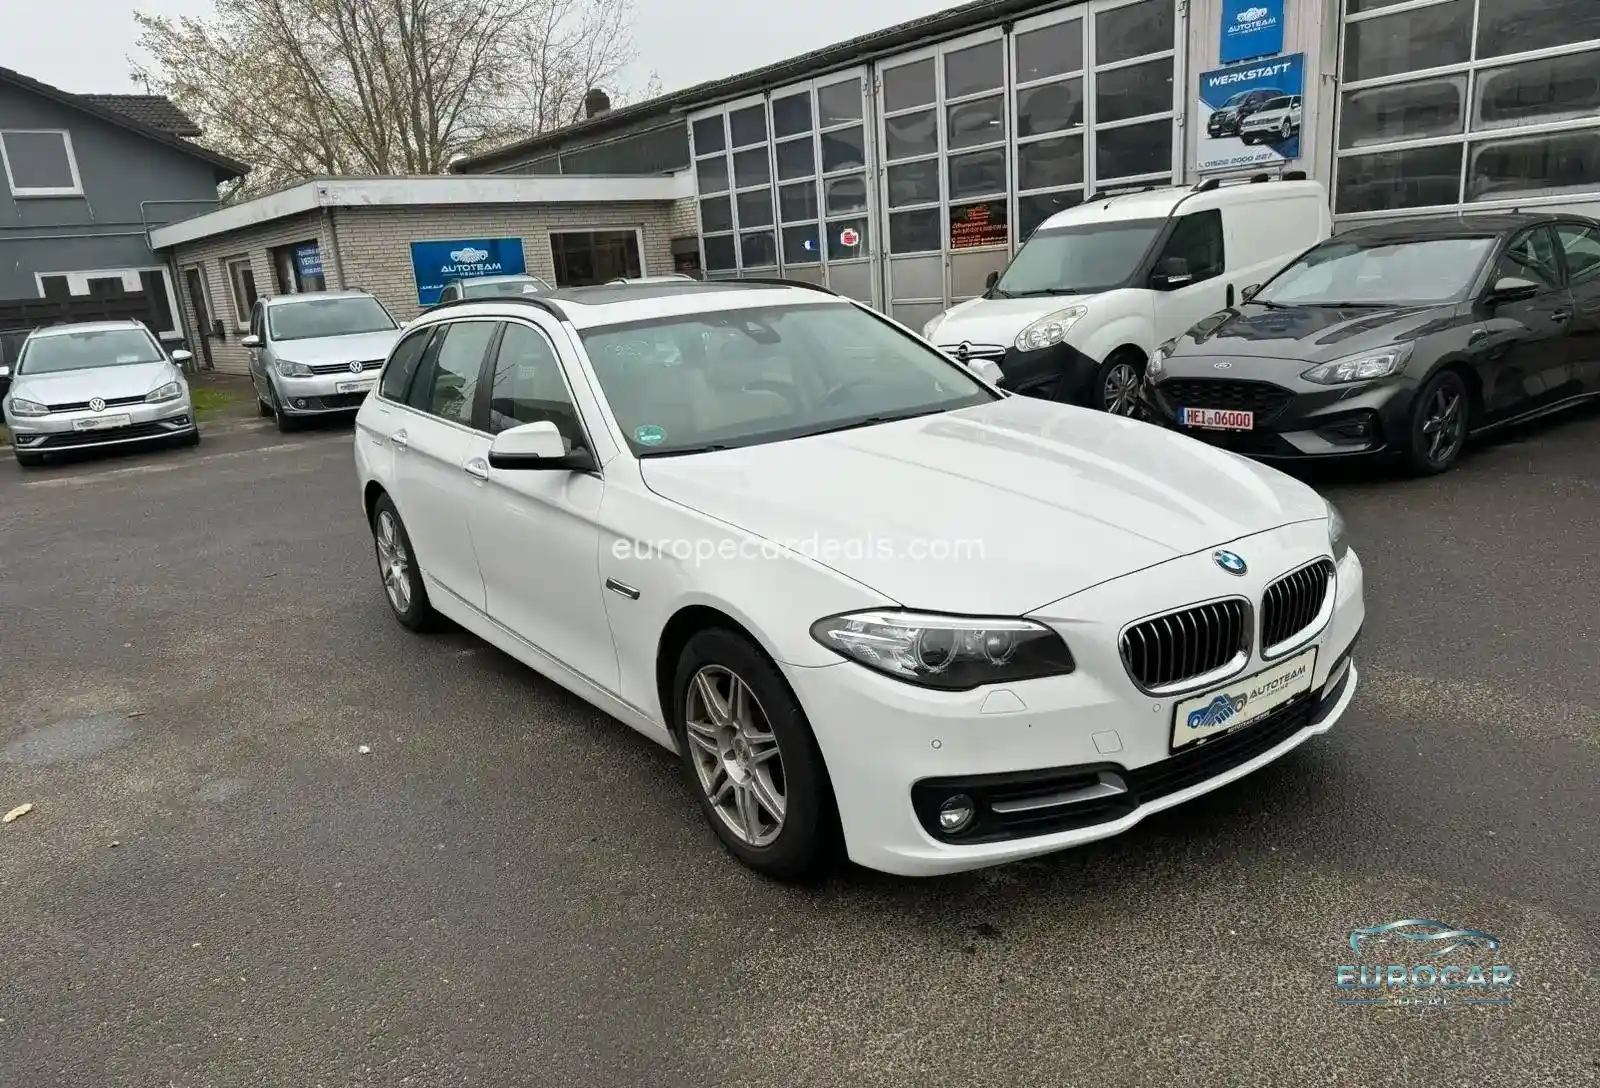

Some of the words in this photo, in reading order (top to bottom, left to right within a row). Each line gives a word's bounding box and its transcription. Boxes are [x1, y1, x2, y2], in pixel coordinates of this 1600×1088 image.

[1227, 17, 1277, 33] AUTOTEAM
[1209, 62, 1292, 87] WERKSTATT
[440, 263, 502, 273] AUTOTEAM
[1187, 409, 1205, 424] HEI
[1214, 411, 1250, 427] 06000
[1249, 665, 1306, 699] AUTOTEAM
